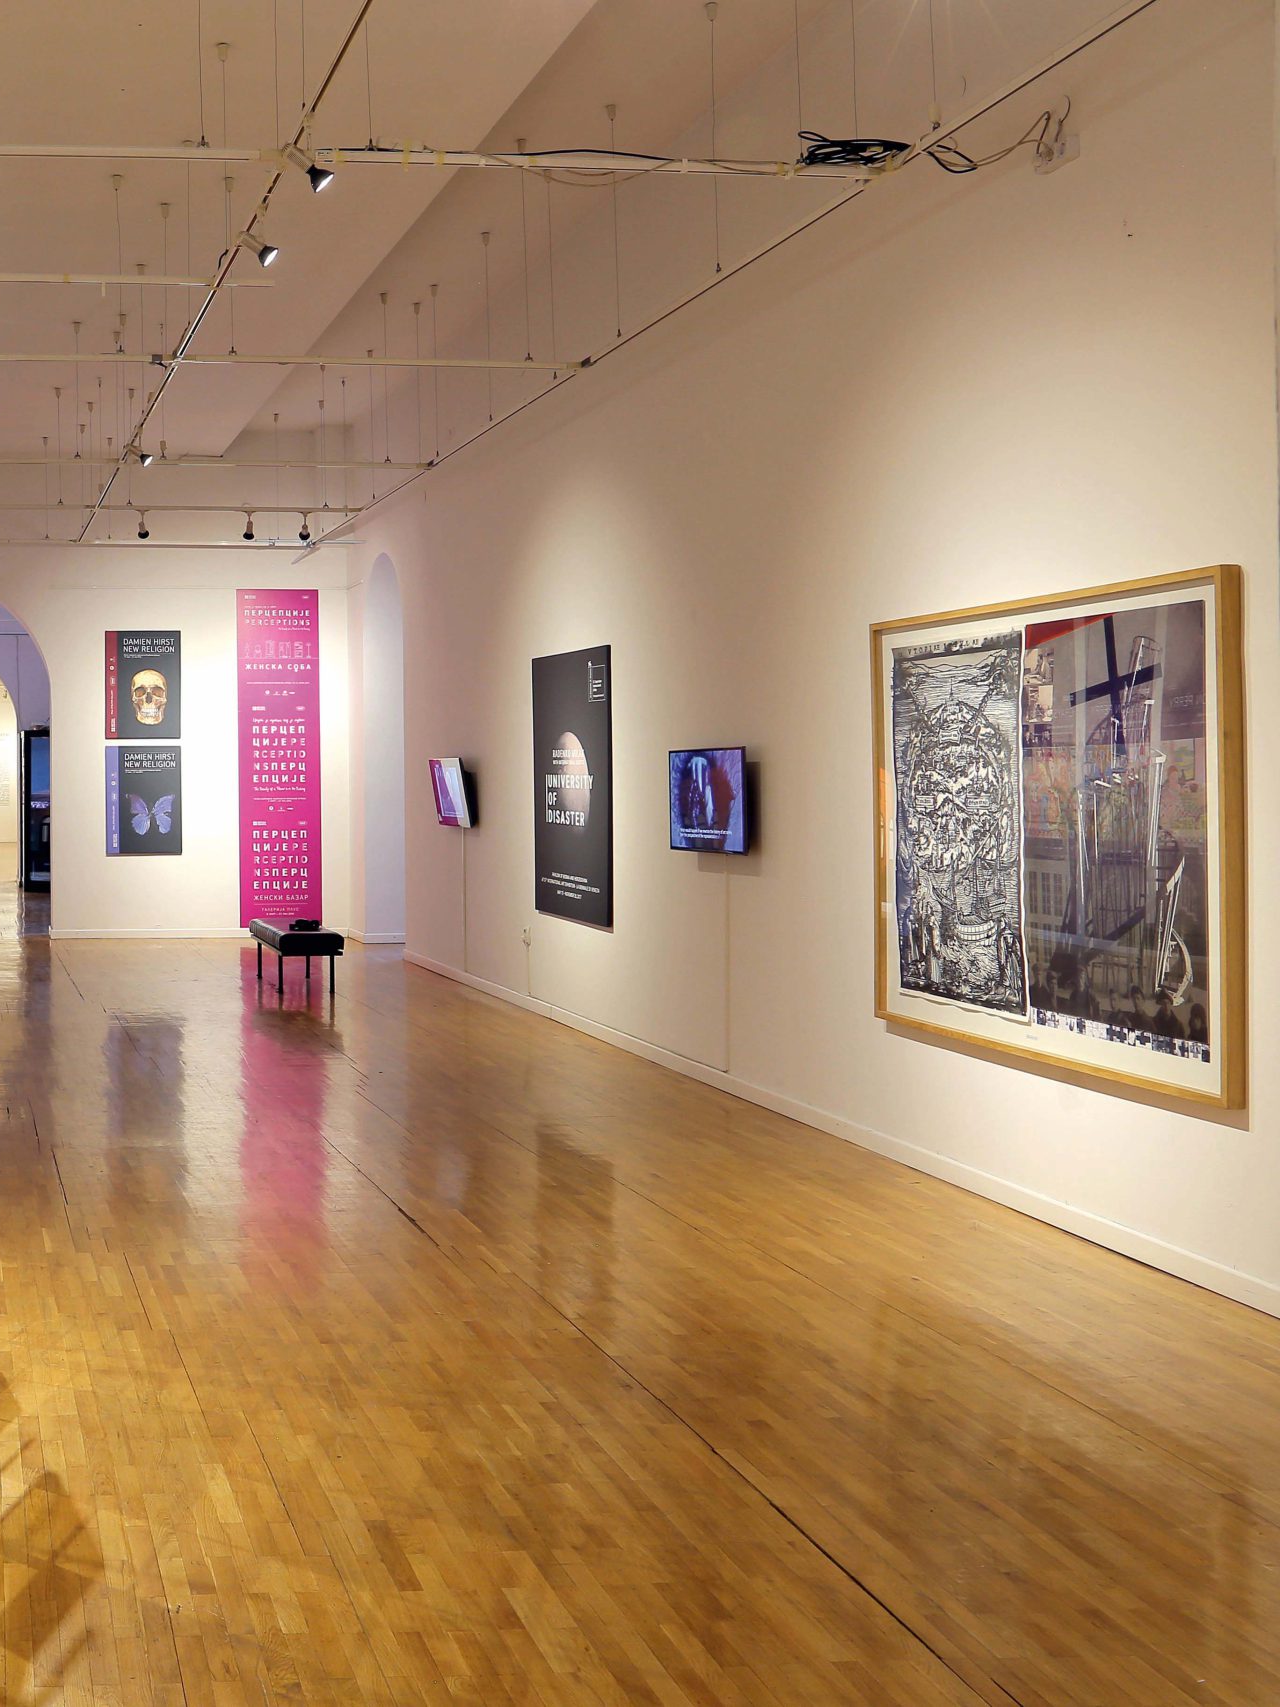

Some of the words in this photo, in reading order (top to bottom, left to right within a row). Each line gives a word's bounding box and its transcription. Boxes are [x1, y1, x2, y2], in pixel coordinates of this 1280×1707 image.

[244, 609, 310, 617] ПЕРЦЕПЦИЈЕ
[123, 638, 152, 646] DAMIEN
[153, 638, 175, 646] HIRST
[123, 645, 139, 653] NEW
[141, 645, 175, 653] RELIGION
[124, 760, 140, 768] NEW
[142, 760, 176, 768] RELIGION
[548, 774, 594, 790] UNIVERSITY
[548, 791, 557, 806] OF
[548, 809, 585, 827] DISASTER
